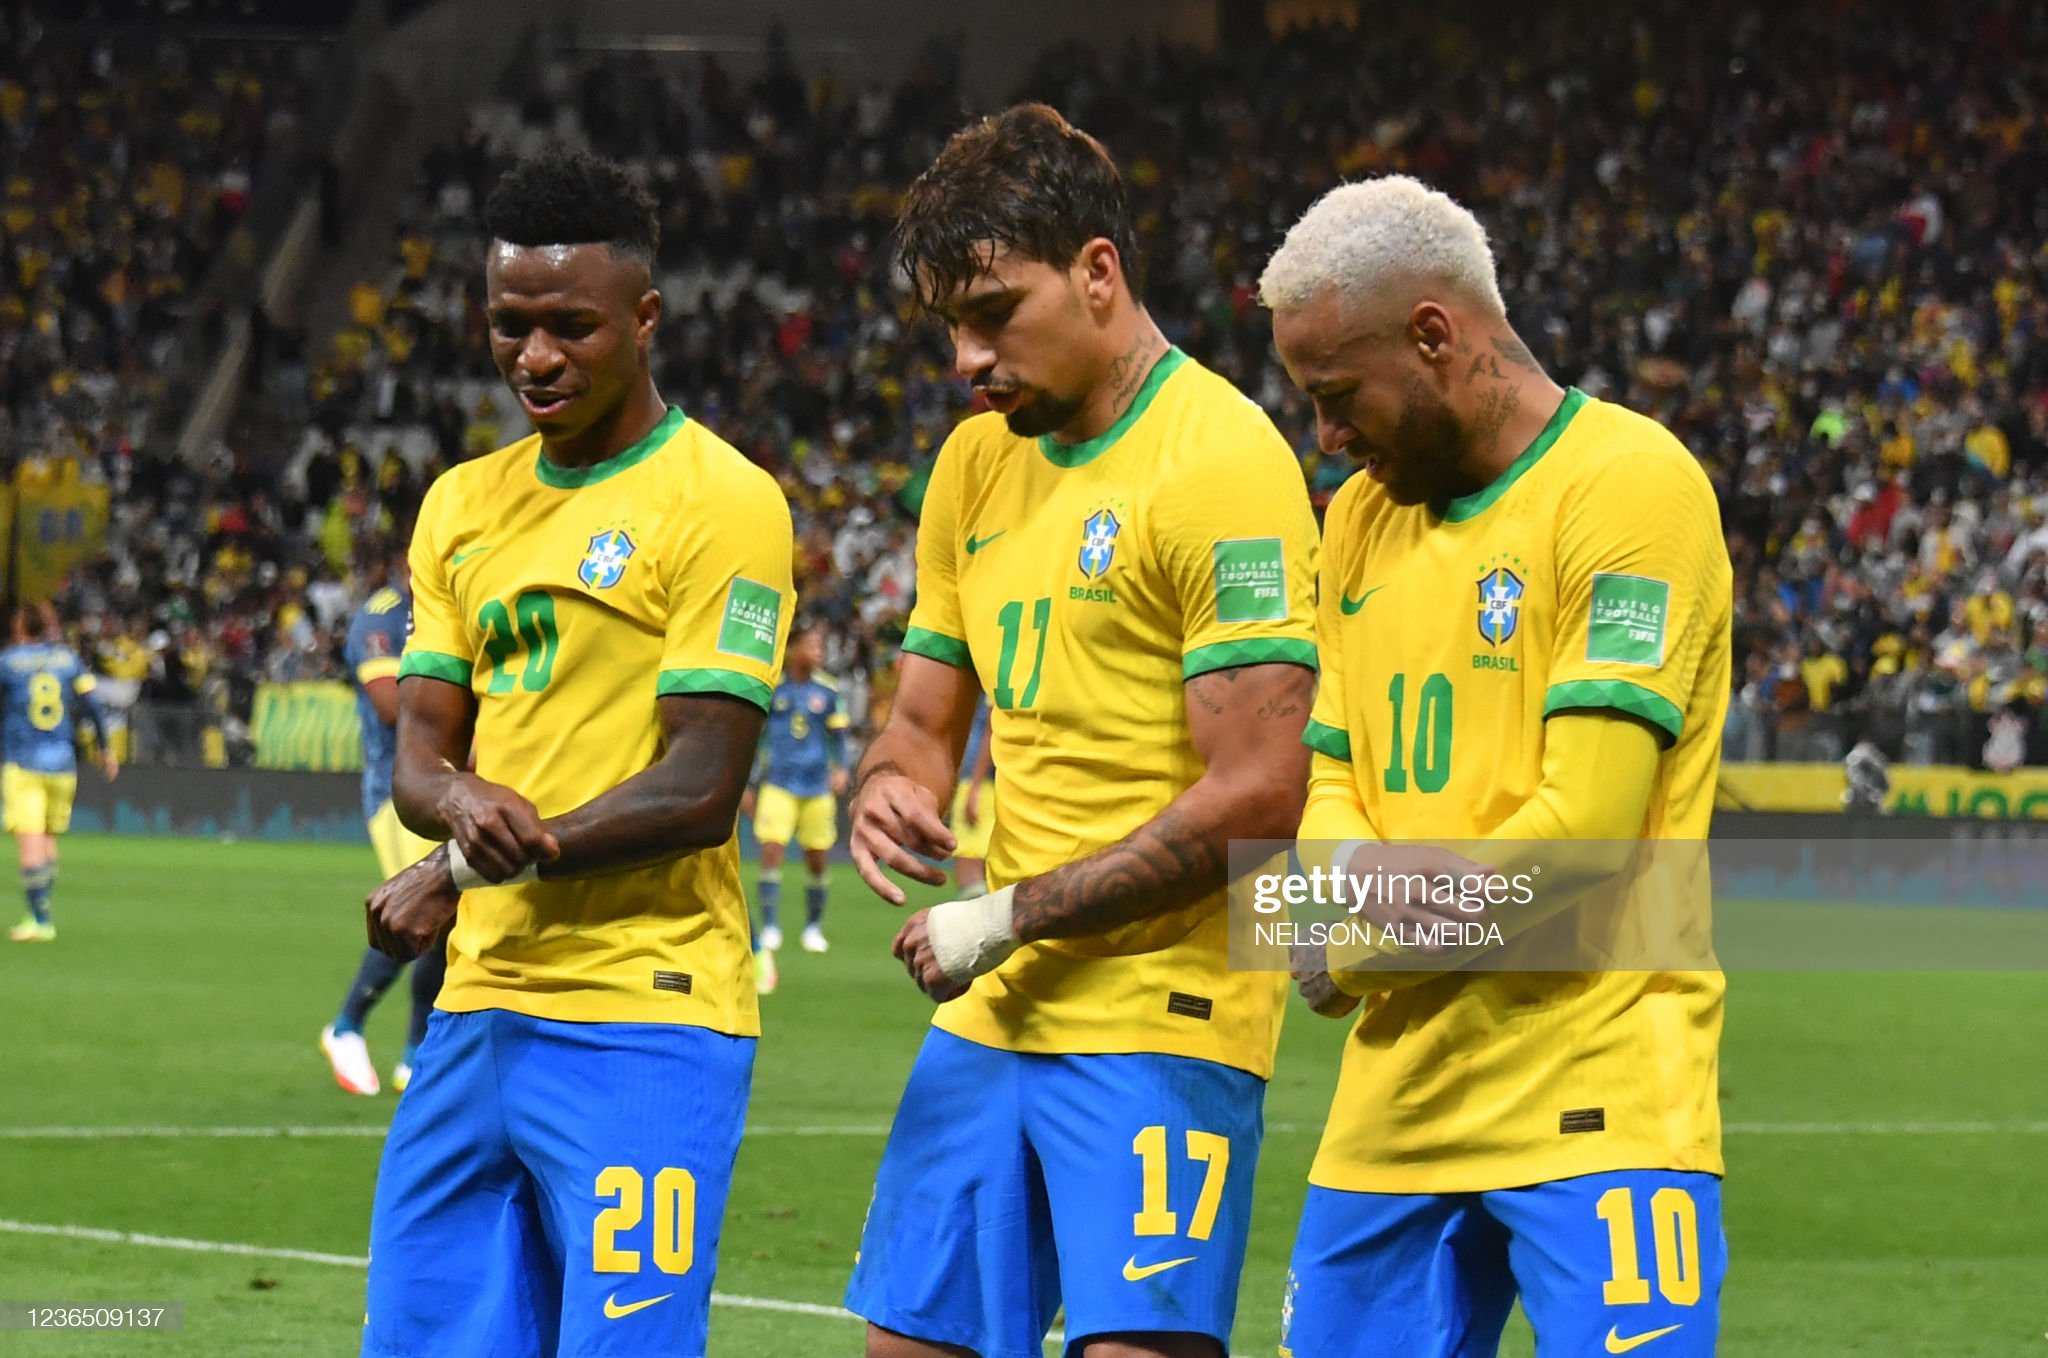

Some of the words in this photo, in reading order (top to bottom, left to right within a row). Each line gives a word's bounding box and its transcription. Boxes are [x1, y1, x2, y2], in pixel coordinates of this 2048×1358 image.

[1092, 537, 1106, 547] CBF
[1220, 560, 1279, 572] LIVING
[1221, 570, 1279, 581] FOOTBALL
[1069, 586, 1118, 604] BRASIL
[1254, 586, 1279, 599] FIFA
[1490, 600, 1508, 610] CBF
[1597, 598, 1660, 614] LIVING
[1597, 607, 1658, 623] FOOTBALL
[478, 590, 559, 694] 20
[1628, 629, 1657, 644] FIFA
[1472, 654, 1520, 673] BRASIL
[28, 672, 64, 732] 8
[1384, 673, 1453, 793] 10
[1132, 1125, 1231, 1241] 17
[593, 1166, 697, 1275] 20
[1595, 1187, 1701, 1306] 10
